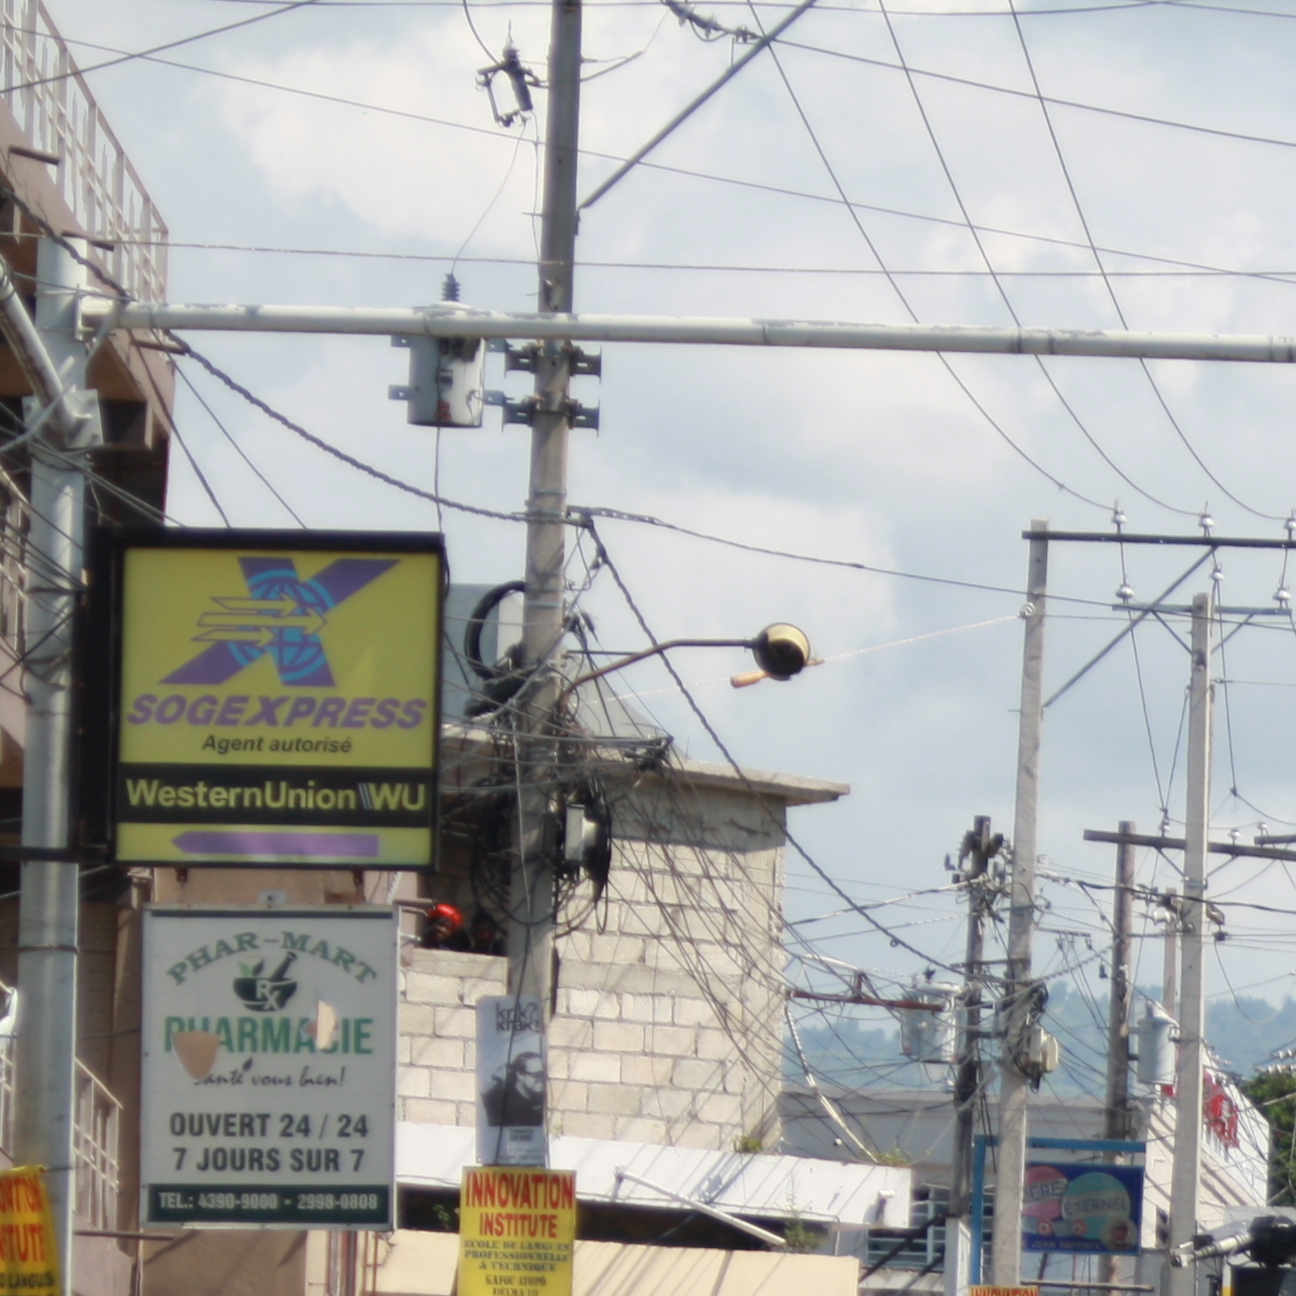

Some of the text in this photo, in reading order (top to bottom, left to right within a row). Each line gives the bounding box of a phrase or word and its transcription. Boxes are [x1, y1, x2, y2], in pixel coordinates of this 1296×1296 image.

[127, 693, 427, 729] SOGEXPRESS
[202, 734, 353, 755] Agent autorisé
[126, 779, 425, 811] WesternUnion WU
[166, 931, 378, 986] PHAR-MART
[194, 1062, 248, 1087] anté
[252, 1072, 292, 1087] vous
[169, 1112, 270, 1137] OUVERT
[279, 1113, 311, 1138] 24
[337, 1114, 368, 1138] 24
[172, 1147, 365, 1173] 7 JOURS SUR 7
[465, 1171, 575, 1210] INNOVATION
[479, 1212, 558, 1239] INSTITUTE
